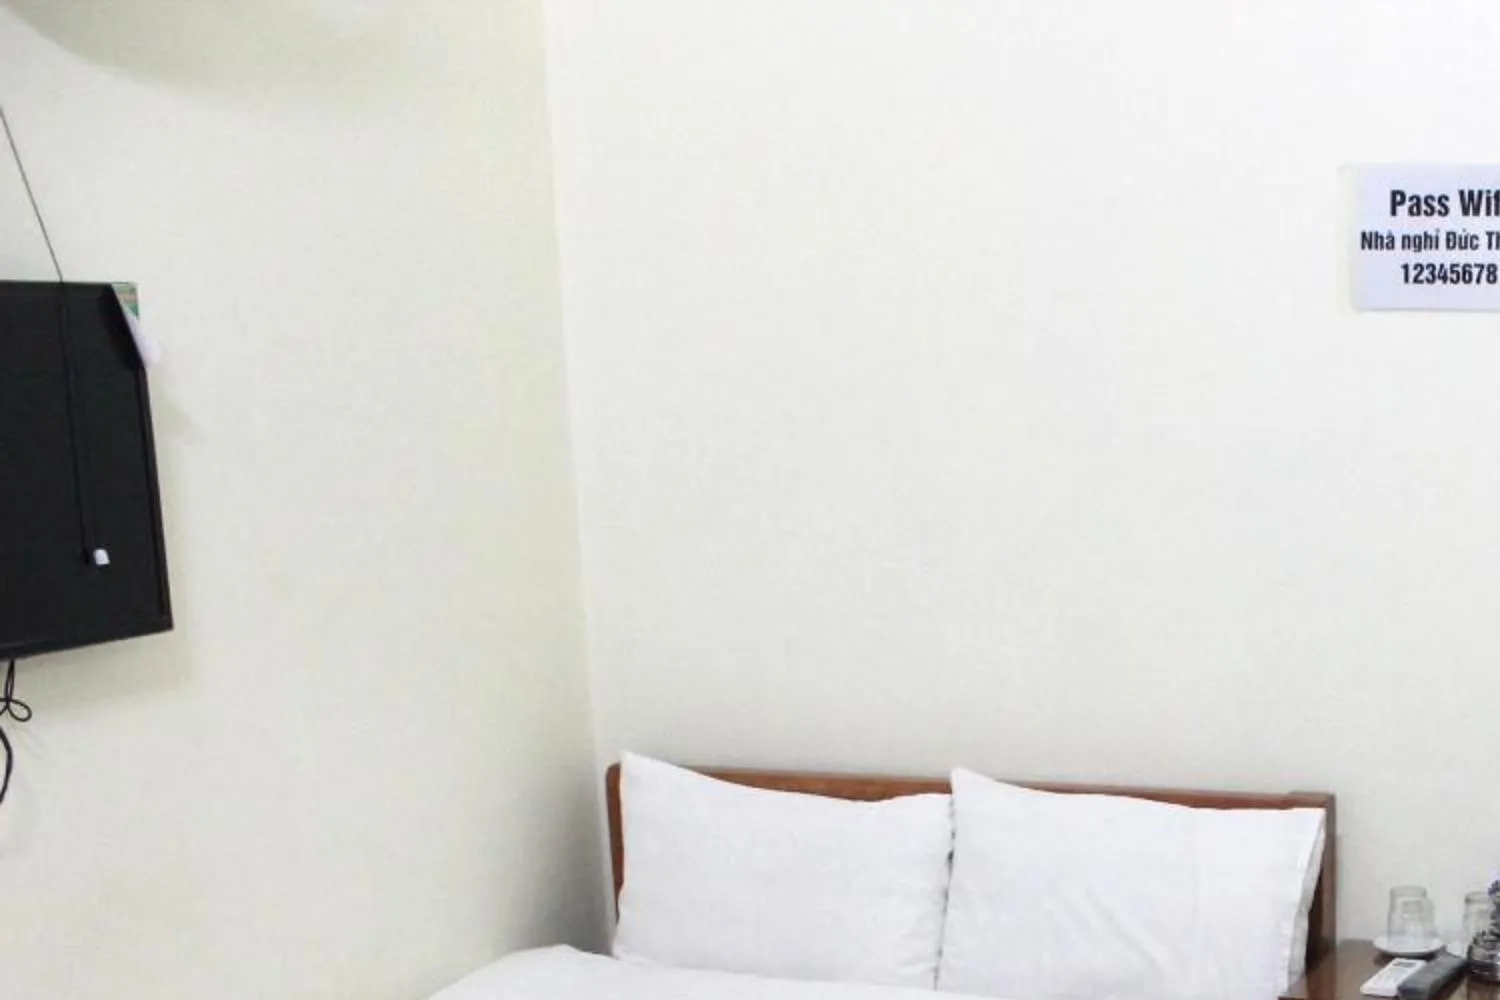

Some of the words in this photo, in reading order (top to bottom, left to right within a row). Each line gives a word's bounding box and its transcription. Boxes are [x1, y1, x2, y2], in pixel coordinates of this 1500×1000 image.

[1390, 189, 1450, 217] Pass
[1361, 229, 1395, 250] Nhà
[1446, 228, 1480, 250] Đức
[1401, 263, 1499, 285] 12345678
